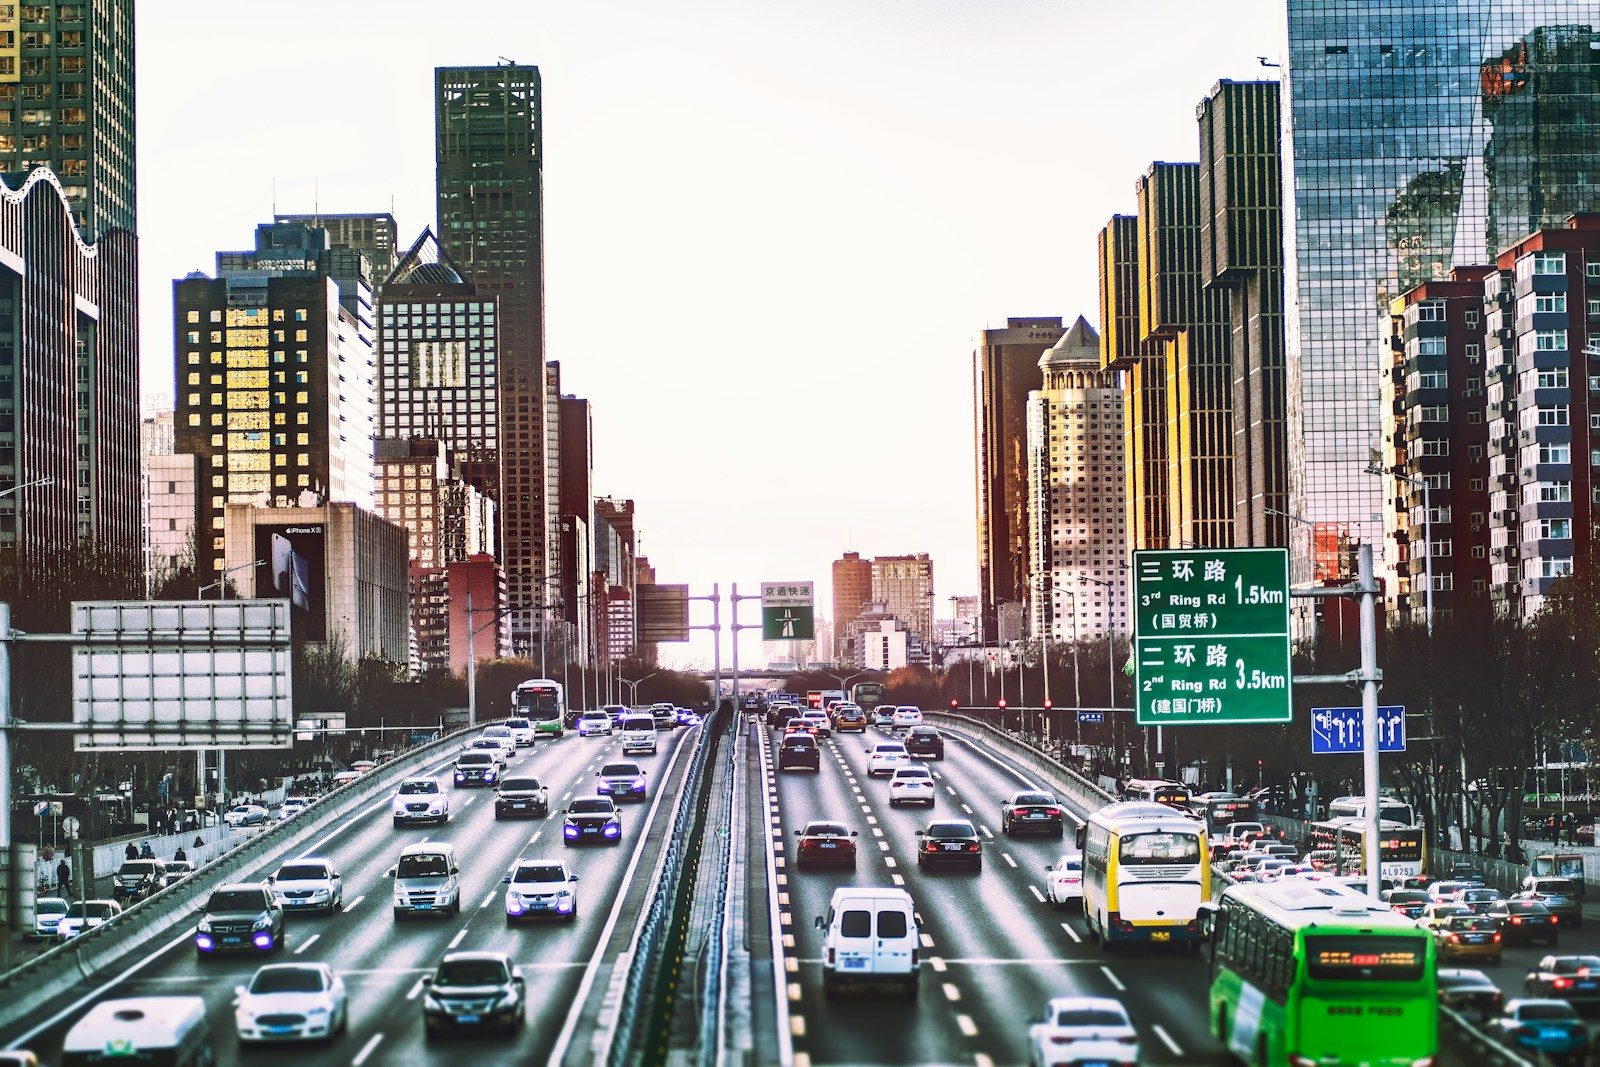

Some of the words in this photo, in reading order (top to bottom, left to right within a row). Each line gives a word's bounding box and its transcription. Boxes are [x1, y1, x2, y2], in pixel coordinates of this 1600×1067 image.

[1141, 559, 1227, 582] 三环路
[765, 586, 810, 597] 京通快速
[1235, 575, 1283, 604] 1.5km
[1141, 592, 1161, 606] 3rd
[1169, 594, 1201, 608] Ring
[1207, 594, 1226, 605] Rd
[1152, 613, 1217, 629] (国贸桥)
[1143, 644, 1228, 667] 二环路
[1236, 659, 1285, 689] 3.5km
[1143, 676, 1164, 691] 2nd
[1171, 679, 1203, 693] Ring
[1209, 679, 1227, 690] Rd
[1151, 698, 1222, 714] (建国门桥)
